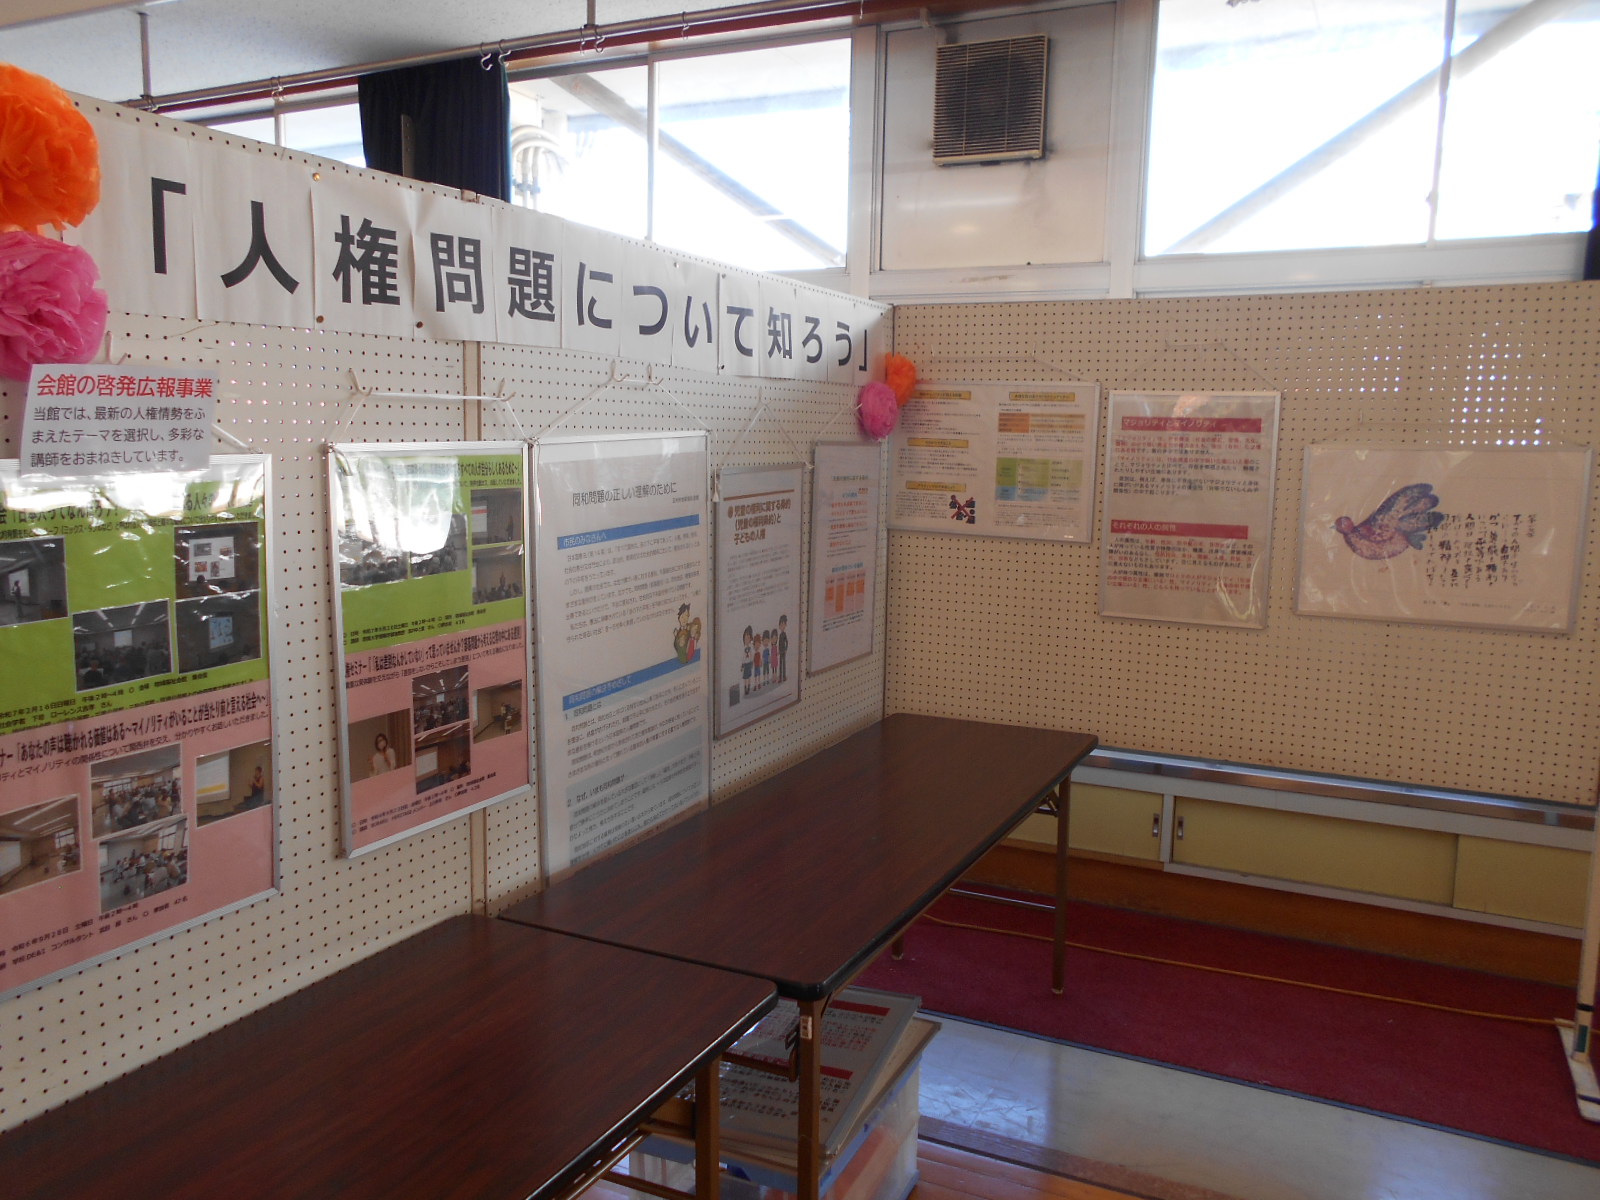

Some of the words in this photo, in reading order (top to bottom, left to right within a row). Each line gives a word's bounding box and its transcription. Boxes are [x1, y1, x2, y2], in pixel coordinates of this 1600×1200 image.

[151, 177, 867, 372] 「人権問題について知ろう」
[37, 374, 213, 398] 会館の啓発広報事業
[33, 406, 206, 421] 当館では、最新の人権情勢をふ
[1122, 417, 1217, 428] マジョリティとマイノリティ
[31, 428, 204, 444] まえたテーマを選択し、多彩な
[30, 450, 185, 468] 講師をおまねきしています。
[572, 482, 678, 507] 同和問題の正しい理解のために
